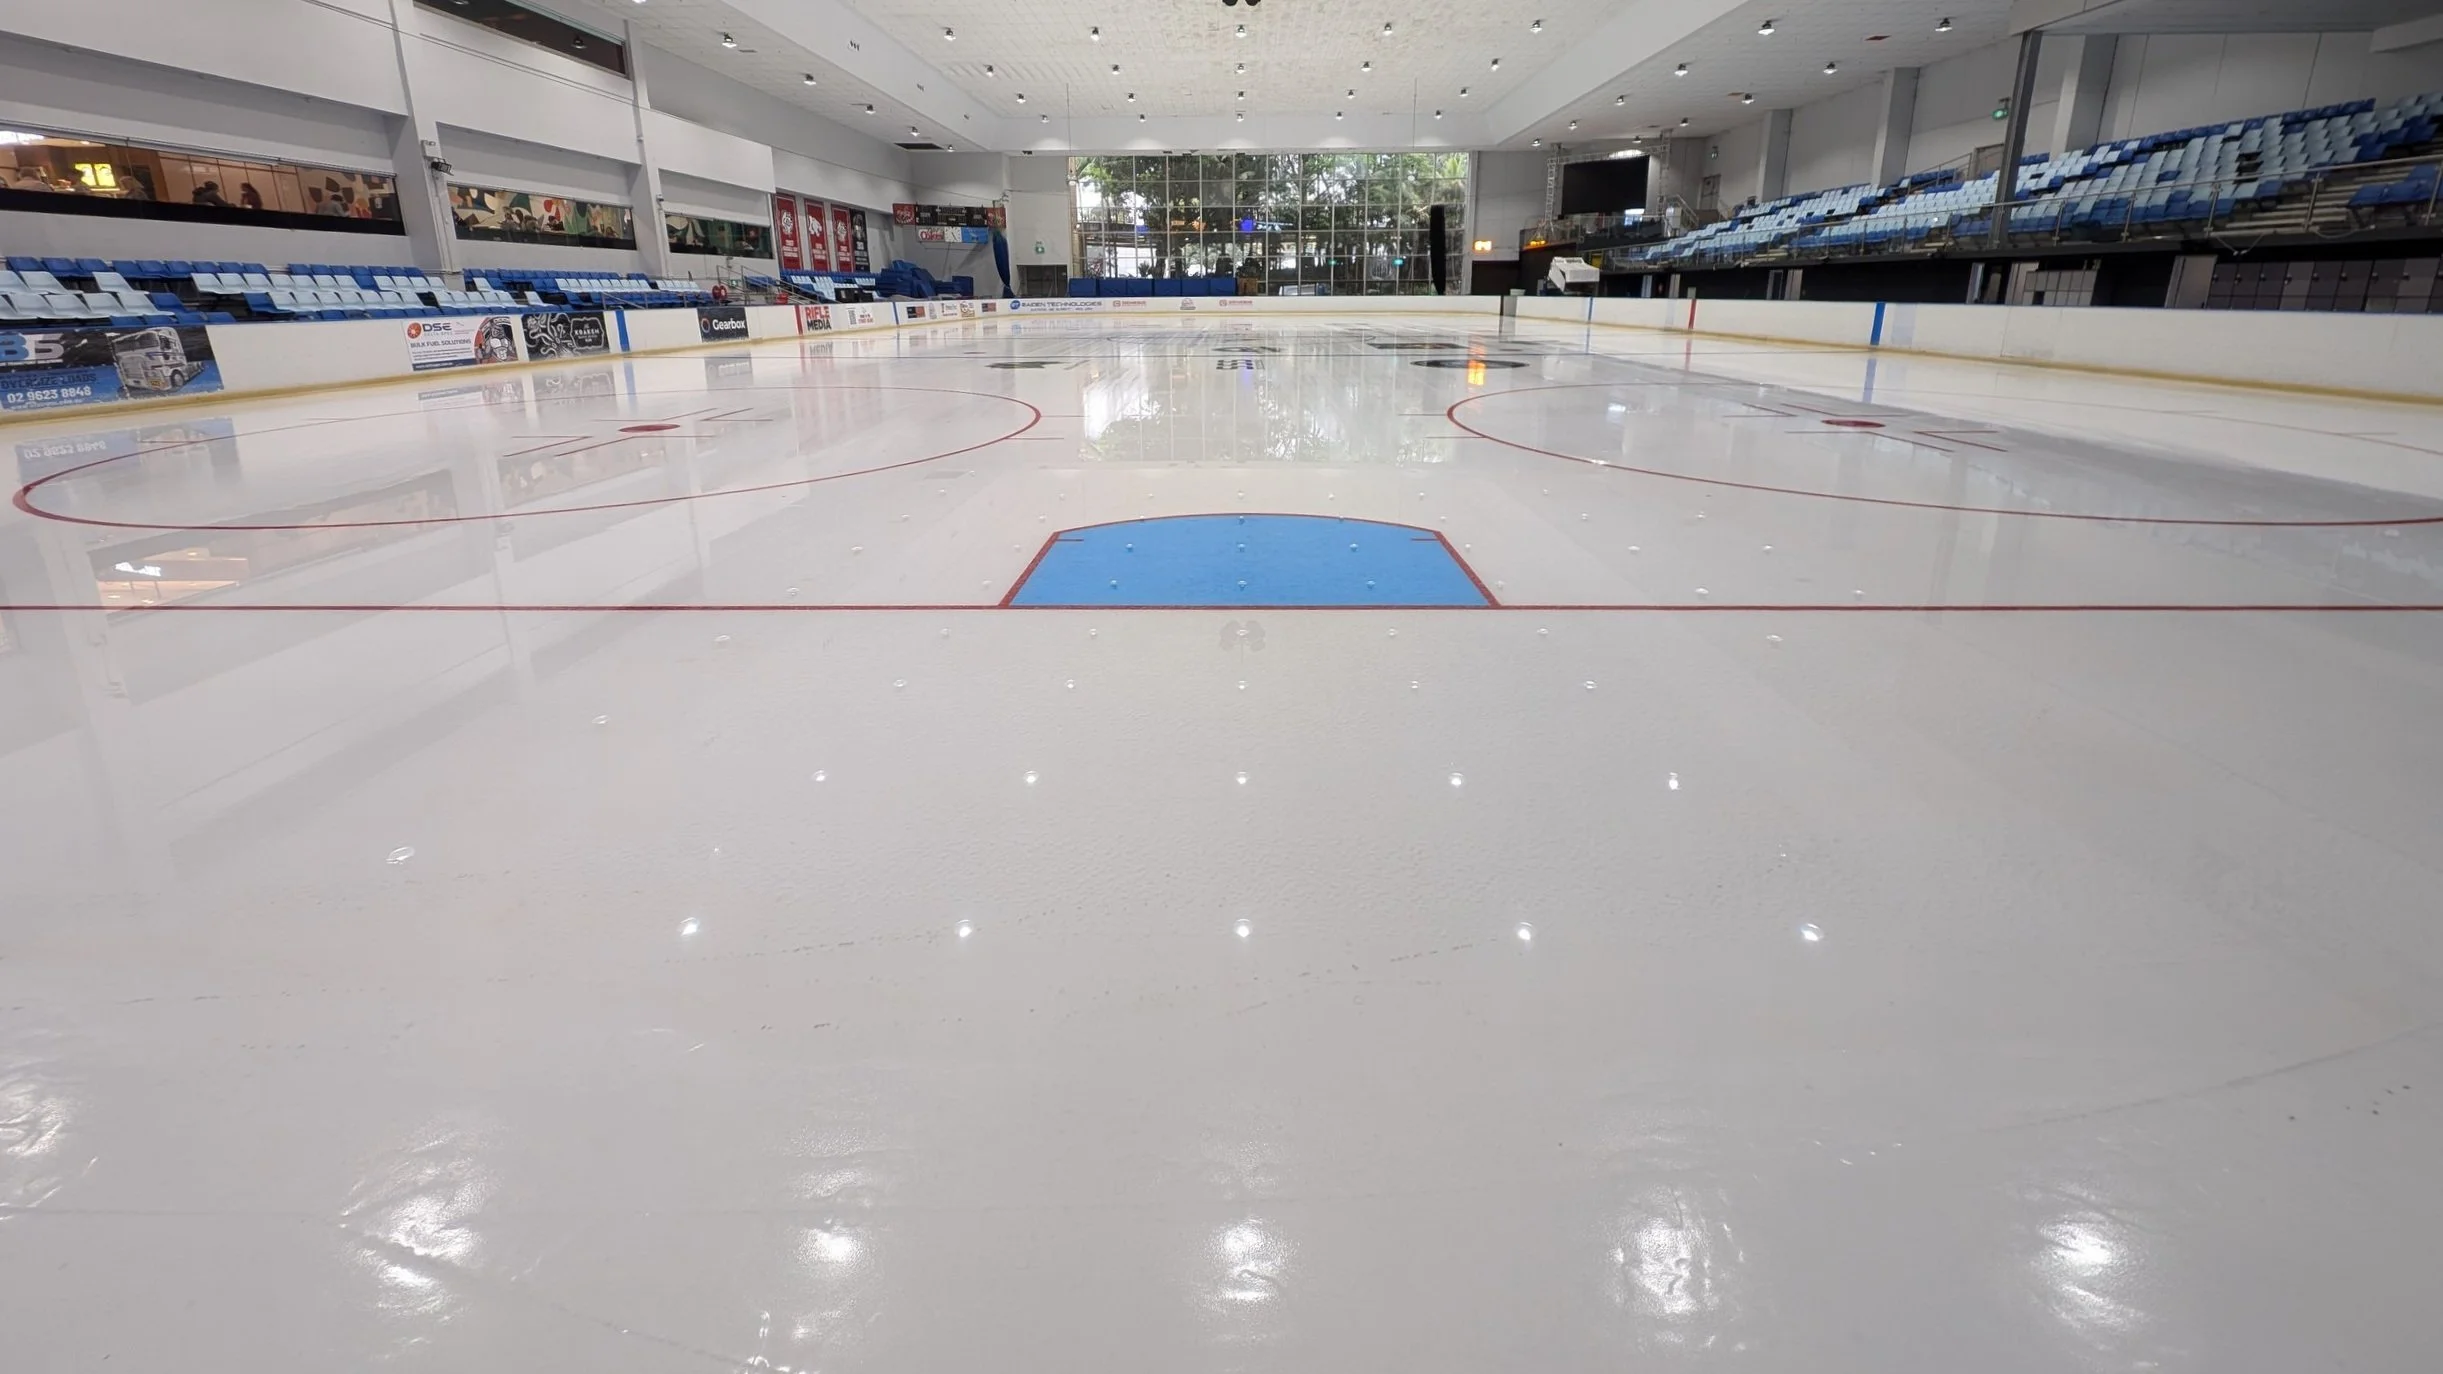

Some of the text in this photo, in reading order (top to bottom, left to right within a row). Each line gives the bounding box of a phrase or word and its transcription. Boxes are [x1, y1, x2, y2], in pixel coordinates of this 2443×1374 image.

[805, 305, 830, 319] RIFLE
[422, 322, 452, 332] DSE
[712, 317, 745, 330] Gearbox
[807, 319, 832, 331] MEDIA
[6, 385, 92, 404] 02 9623 8848
